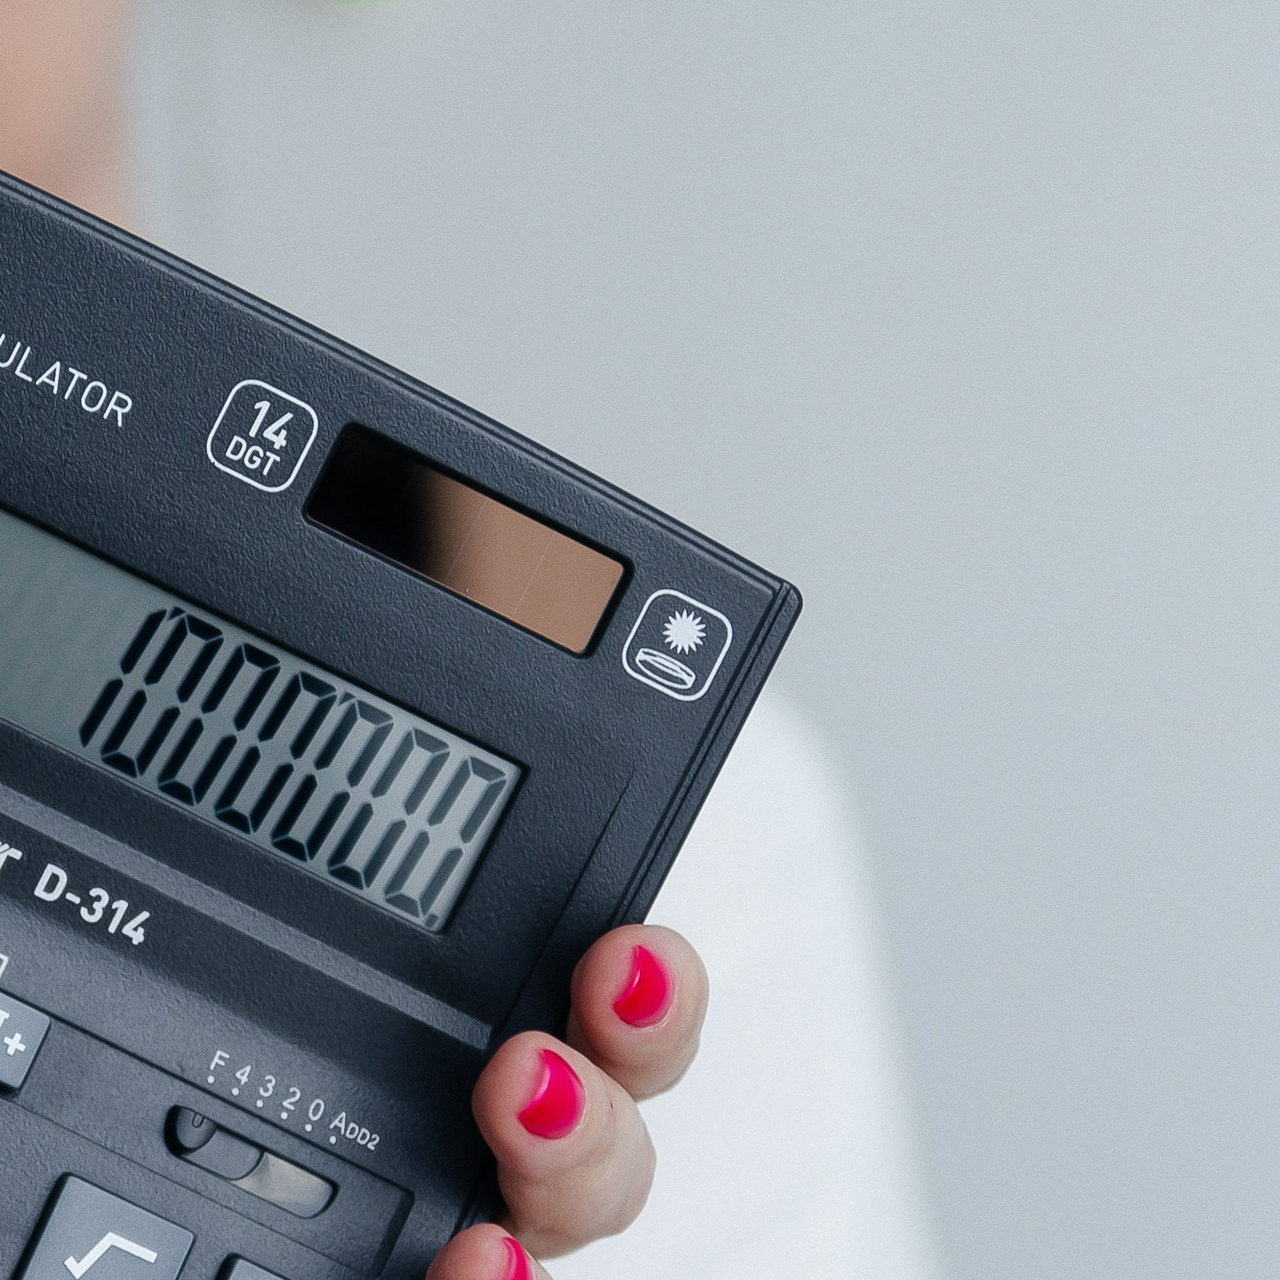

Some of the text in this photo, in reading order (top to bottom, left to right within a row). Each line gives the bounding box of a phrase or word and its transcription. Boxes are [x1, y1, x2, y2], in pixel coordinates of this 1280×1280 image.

[226, 435, 280, 475] DGT
[248, 400, 294, 450] 14
[34, 864, 150, 945] D-314
[210, 1050, 230, 1070] F
[236, 1065, 251, 1085] 4
[260, 1075, 275, 1096] 3
[283, 1087, 301, 1110] 2
[309, 1099, 324, 1121] 0
